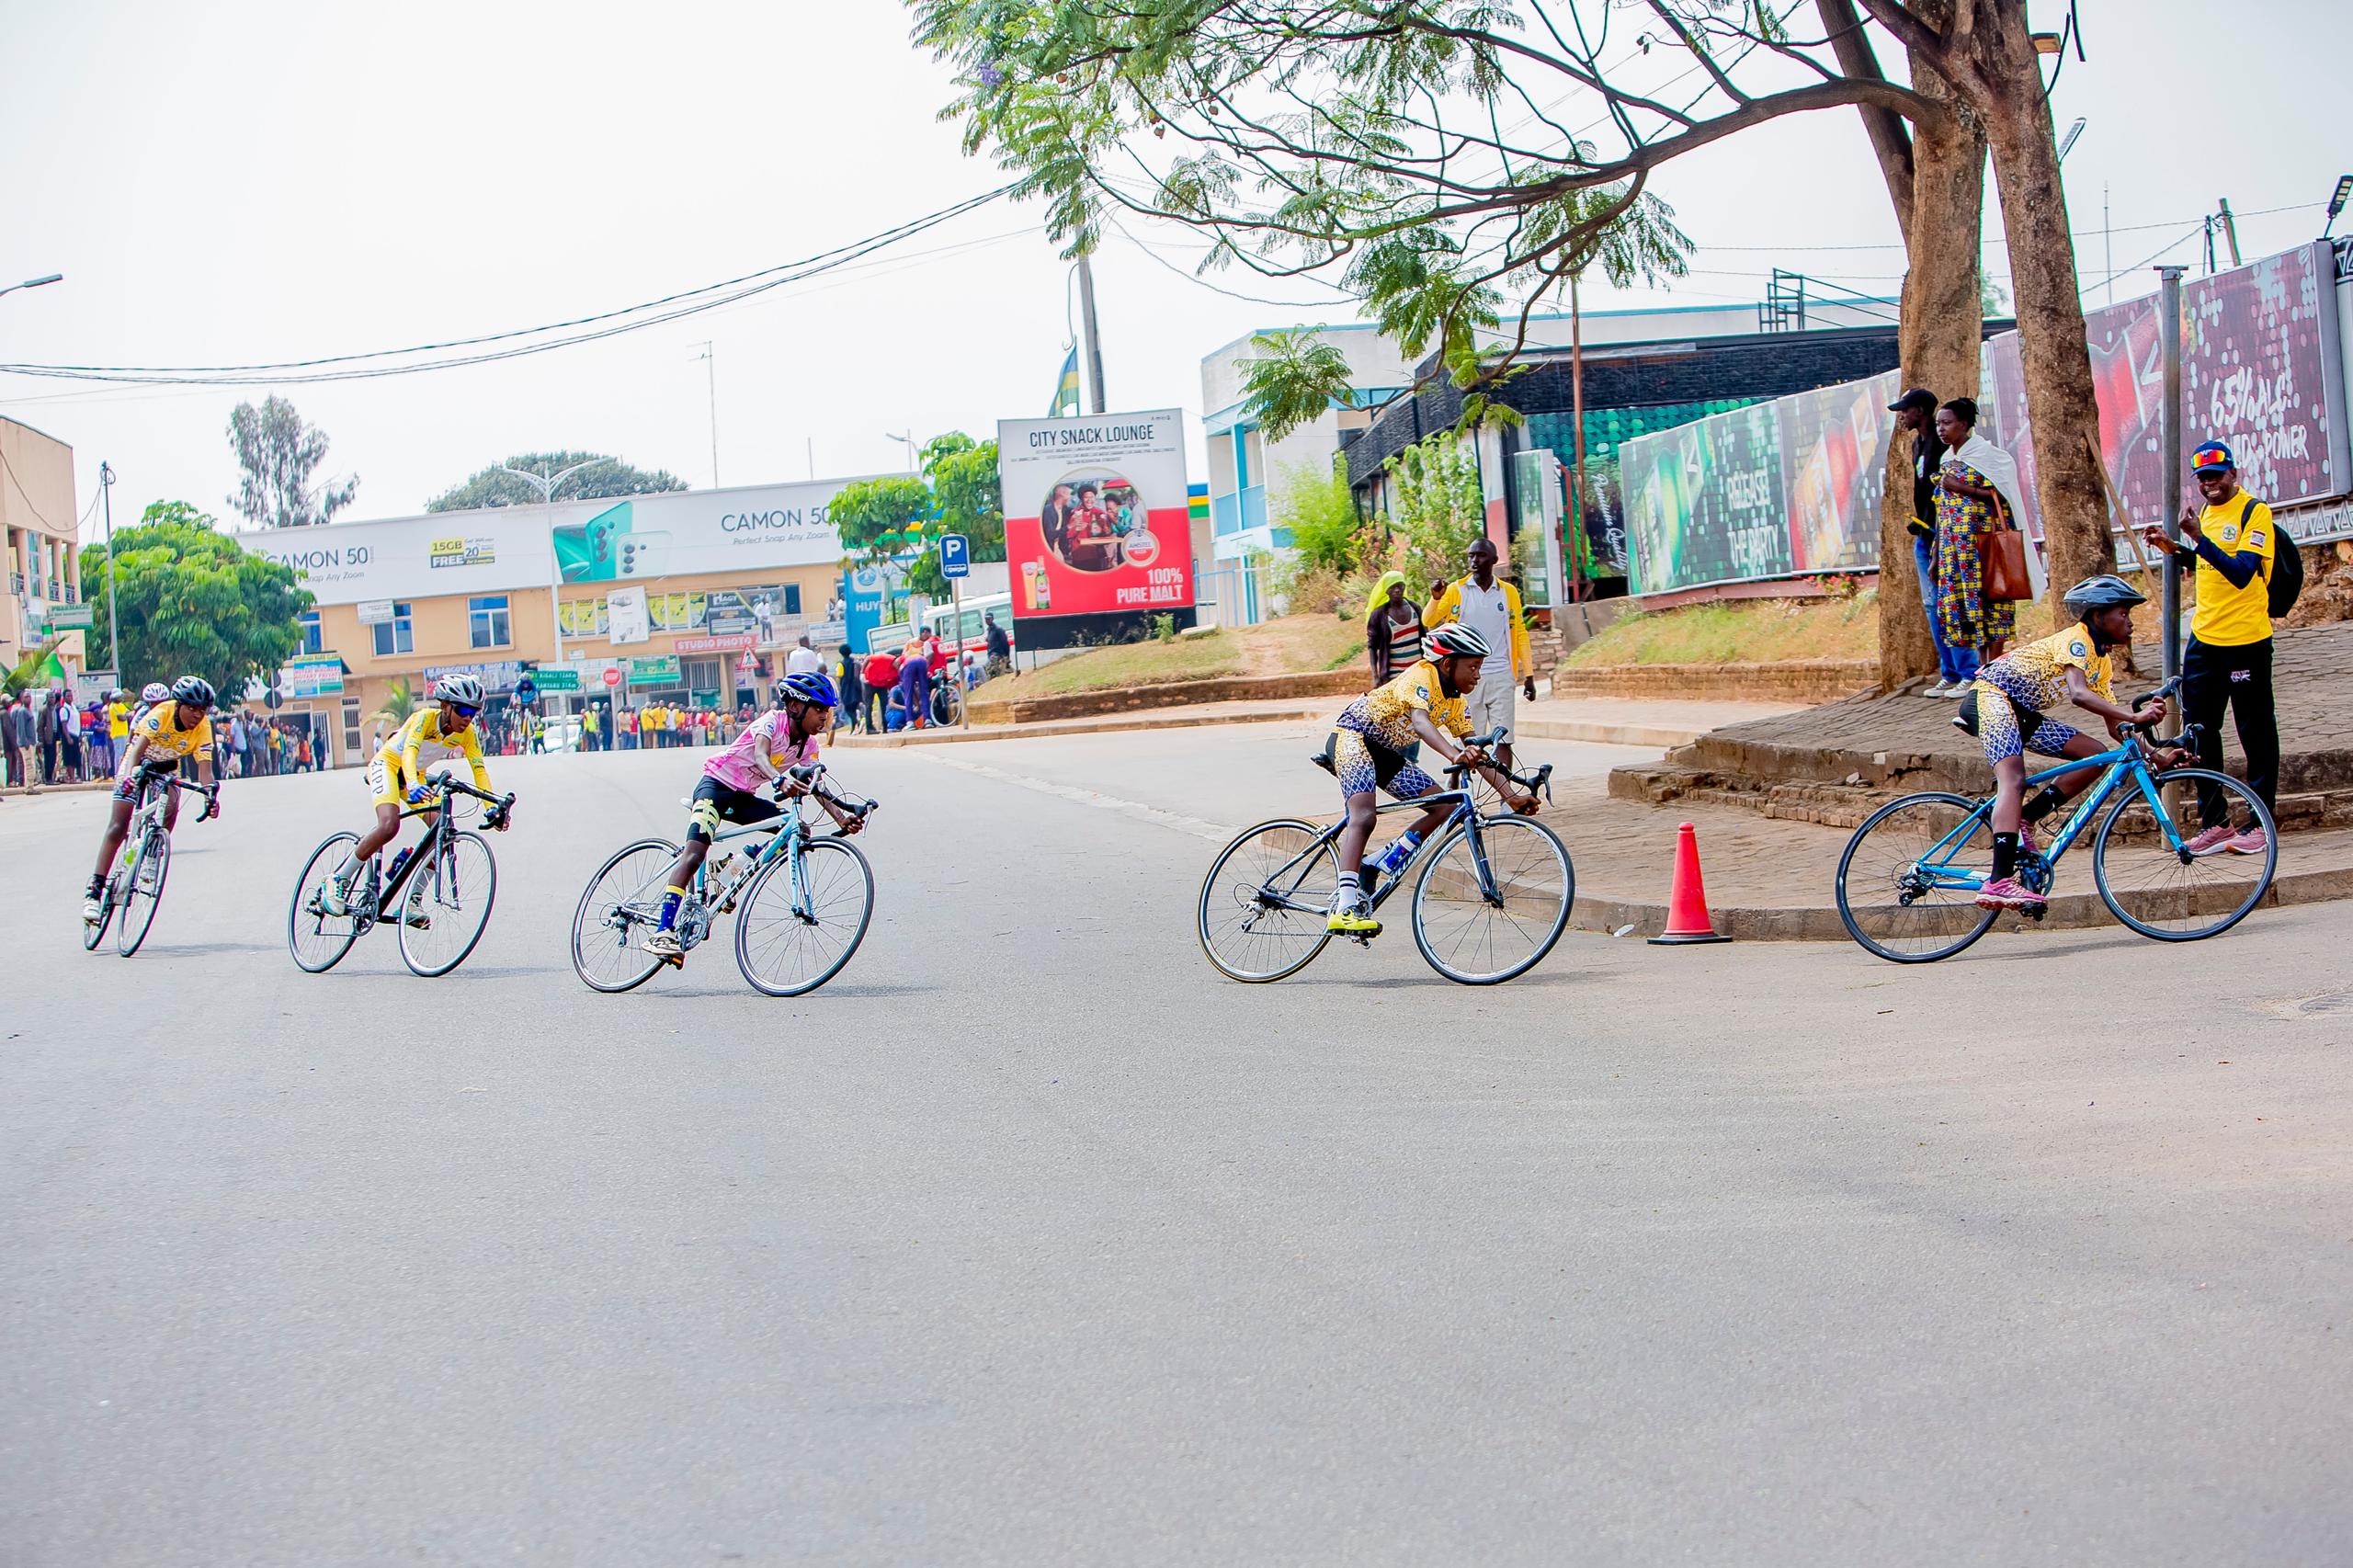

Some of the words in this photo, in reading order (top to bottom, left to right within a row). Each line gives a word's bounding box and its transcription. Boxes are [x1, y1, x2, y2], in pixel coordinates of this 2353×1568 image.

[1029, 430, 1058, 448] CITY
[1061, 426, 1103, 446] SNACK
[1106, 424, 1155, 442] LOUNGE
[2264, 424, 2310, 460] POWER
[1727, 468, 1771, 512] RELEASE
[721, 508, 801, 532] CAMON
[810, 506, 831, 525] 50
[433, 540, 463, 551] 15GB
[733, 536, 763, 545] Perfect
[764, 534, 786, 543] Snap
[787, 533, 804, 541] Any
[806, 531, 830, 540] Zoom
[1727, 528, 1749, 569] THE
[1747, 524, 1779, 564] PARTY
[347, 546, 369, 565] 50
[465, 546, 480, 558] 20
[946, 540, 961, 558] P
[432, 554, 464, 567] FREE
[325, 574, 341, 582] Any
[343, 571, 365, 579] Zoom
[1147, 567, 1184, 585] 100%
[1116, 586, 1149, 605] PURE
[1149, 584, 1184, 603] MALT
[855, 600, 881, 612] HUY
[676, 638, 715, 651] STUDIO
[716, 636, 753, 648] PHOTO
